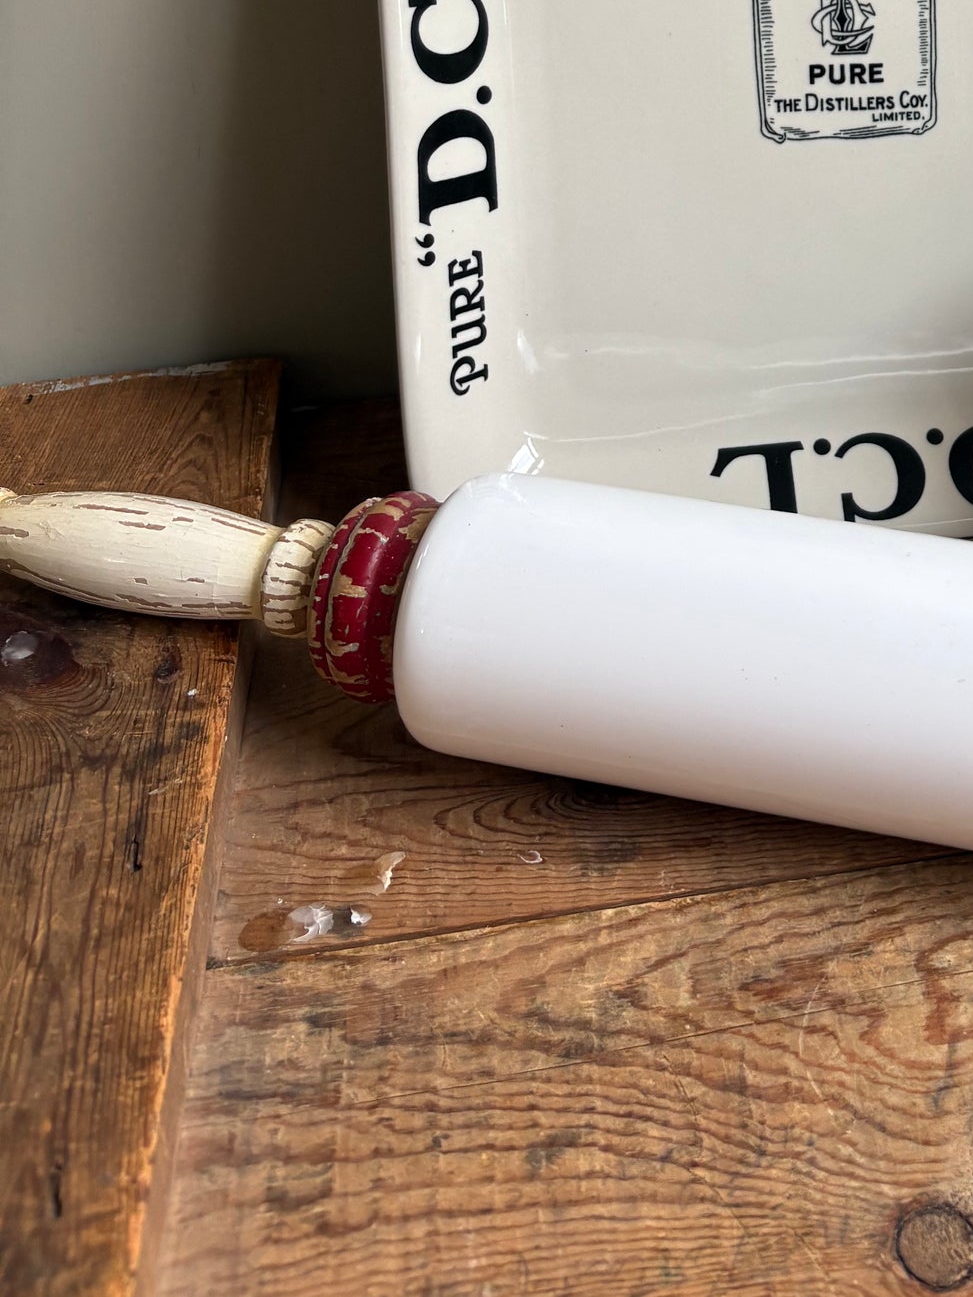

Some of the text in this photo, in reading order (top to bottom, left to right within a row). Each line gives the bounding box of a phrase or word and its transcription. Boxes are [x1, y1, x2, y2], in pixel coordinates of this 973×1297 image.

[808, 63, 884, 84] PURE
[774, 98, 801, 112] THE
[804, 93, 894, 111] DISTILLERS
[448, 250, 489, 395] PURE
